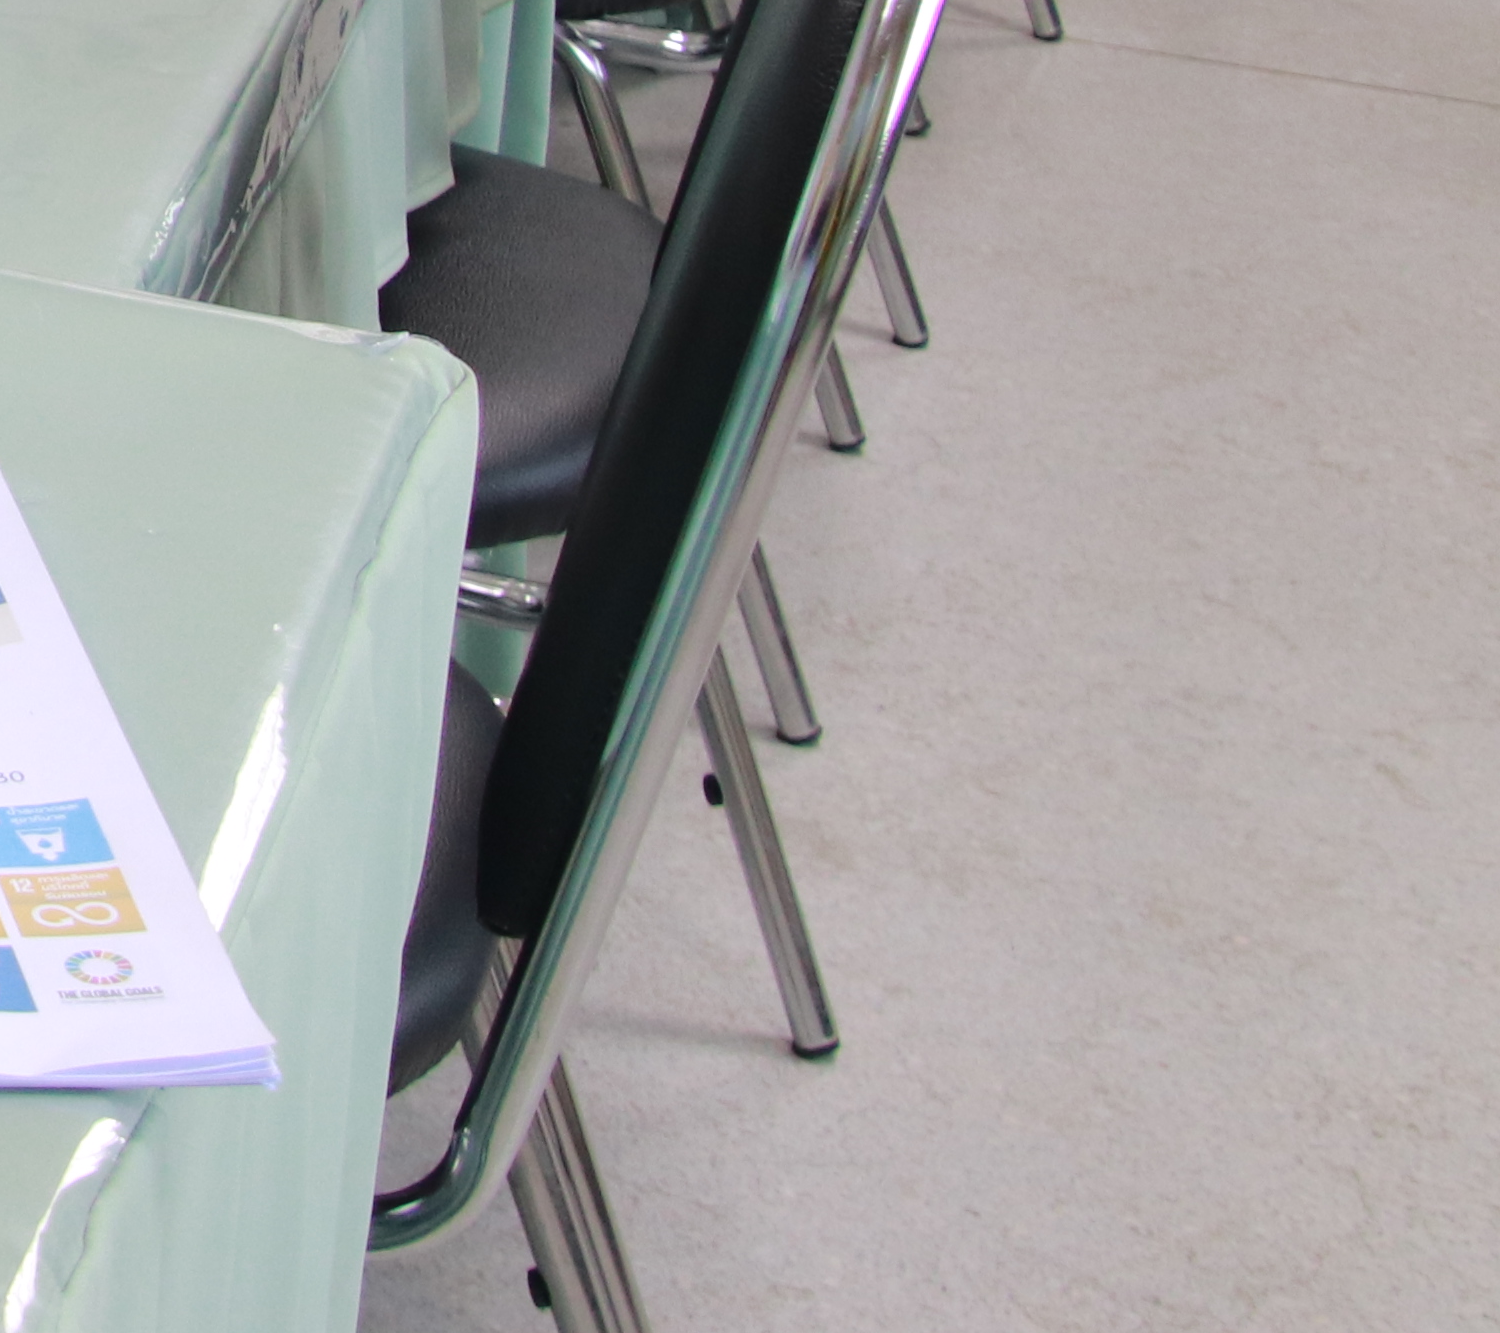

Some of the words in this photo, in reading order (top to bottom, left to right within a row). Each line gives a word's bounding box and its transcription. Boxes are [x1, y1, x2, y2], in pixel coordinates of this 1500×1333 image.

[10, 878, 35, 892] 12
[57, 990, 78, 999] THE
[80, 989, 122, 999] GLOBAL
[125, 986, 163, 997] GOALS
